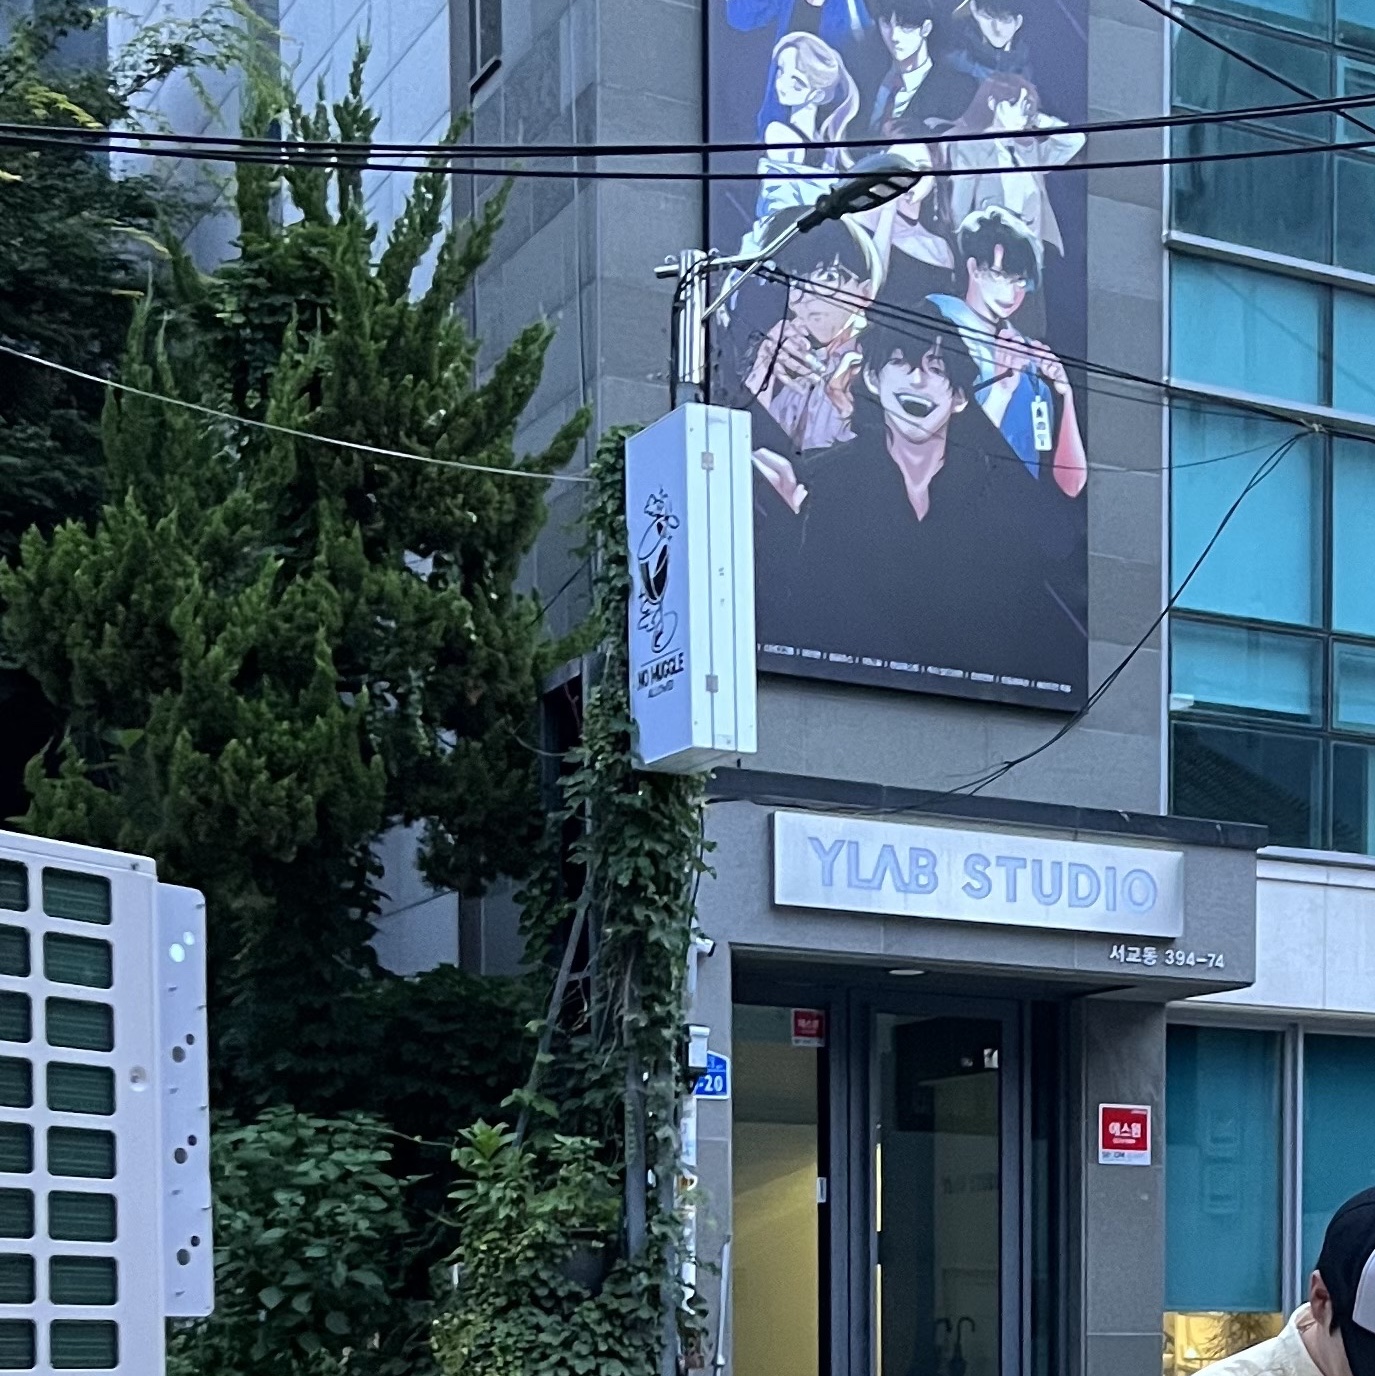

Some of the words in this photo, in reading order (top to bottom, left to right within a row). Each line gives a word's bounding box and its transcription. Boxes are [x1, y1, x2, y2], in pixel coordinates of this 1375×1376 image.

[808, 837, 938, 895] YLAB
[961, 853, 1158, 915] STUDIO
[1109, 944, 1158, 966] 서교동
[1164, 949, 1225, 968] 394-74
